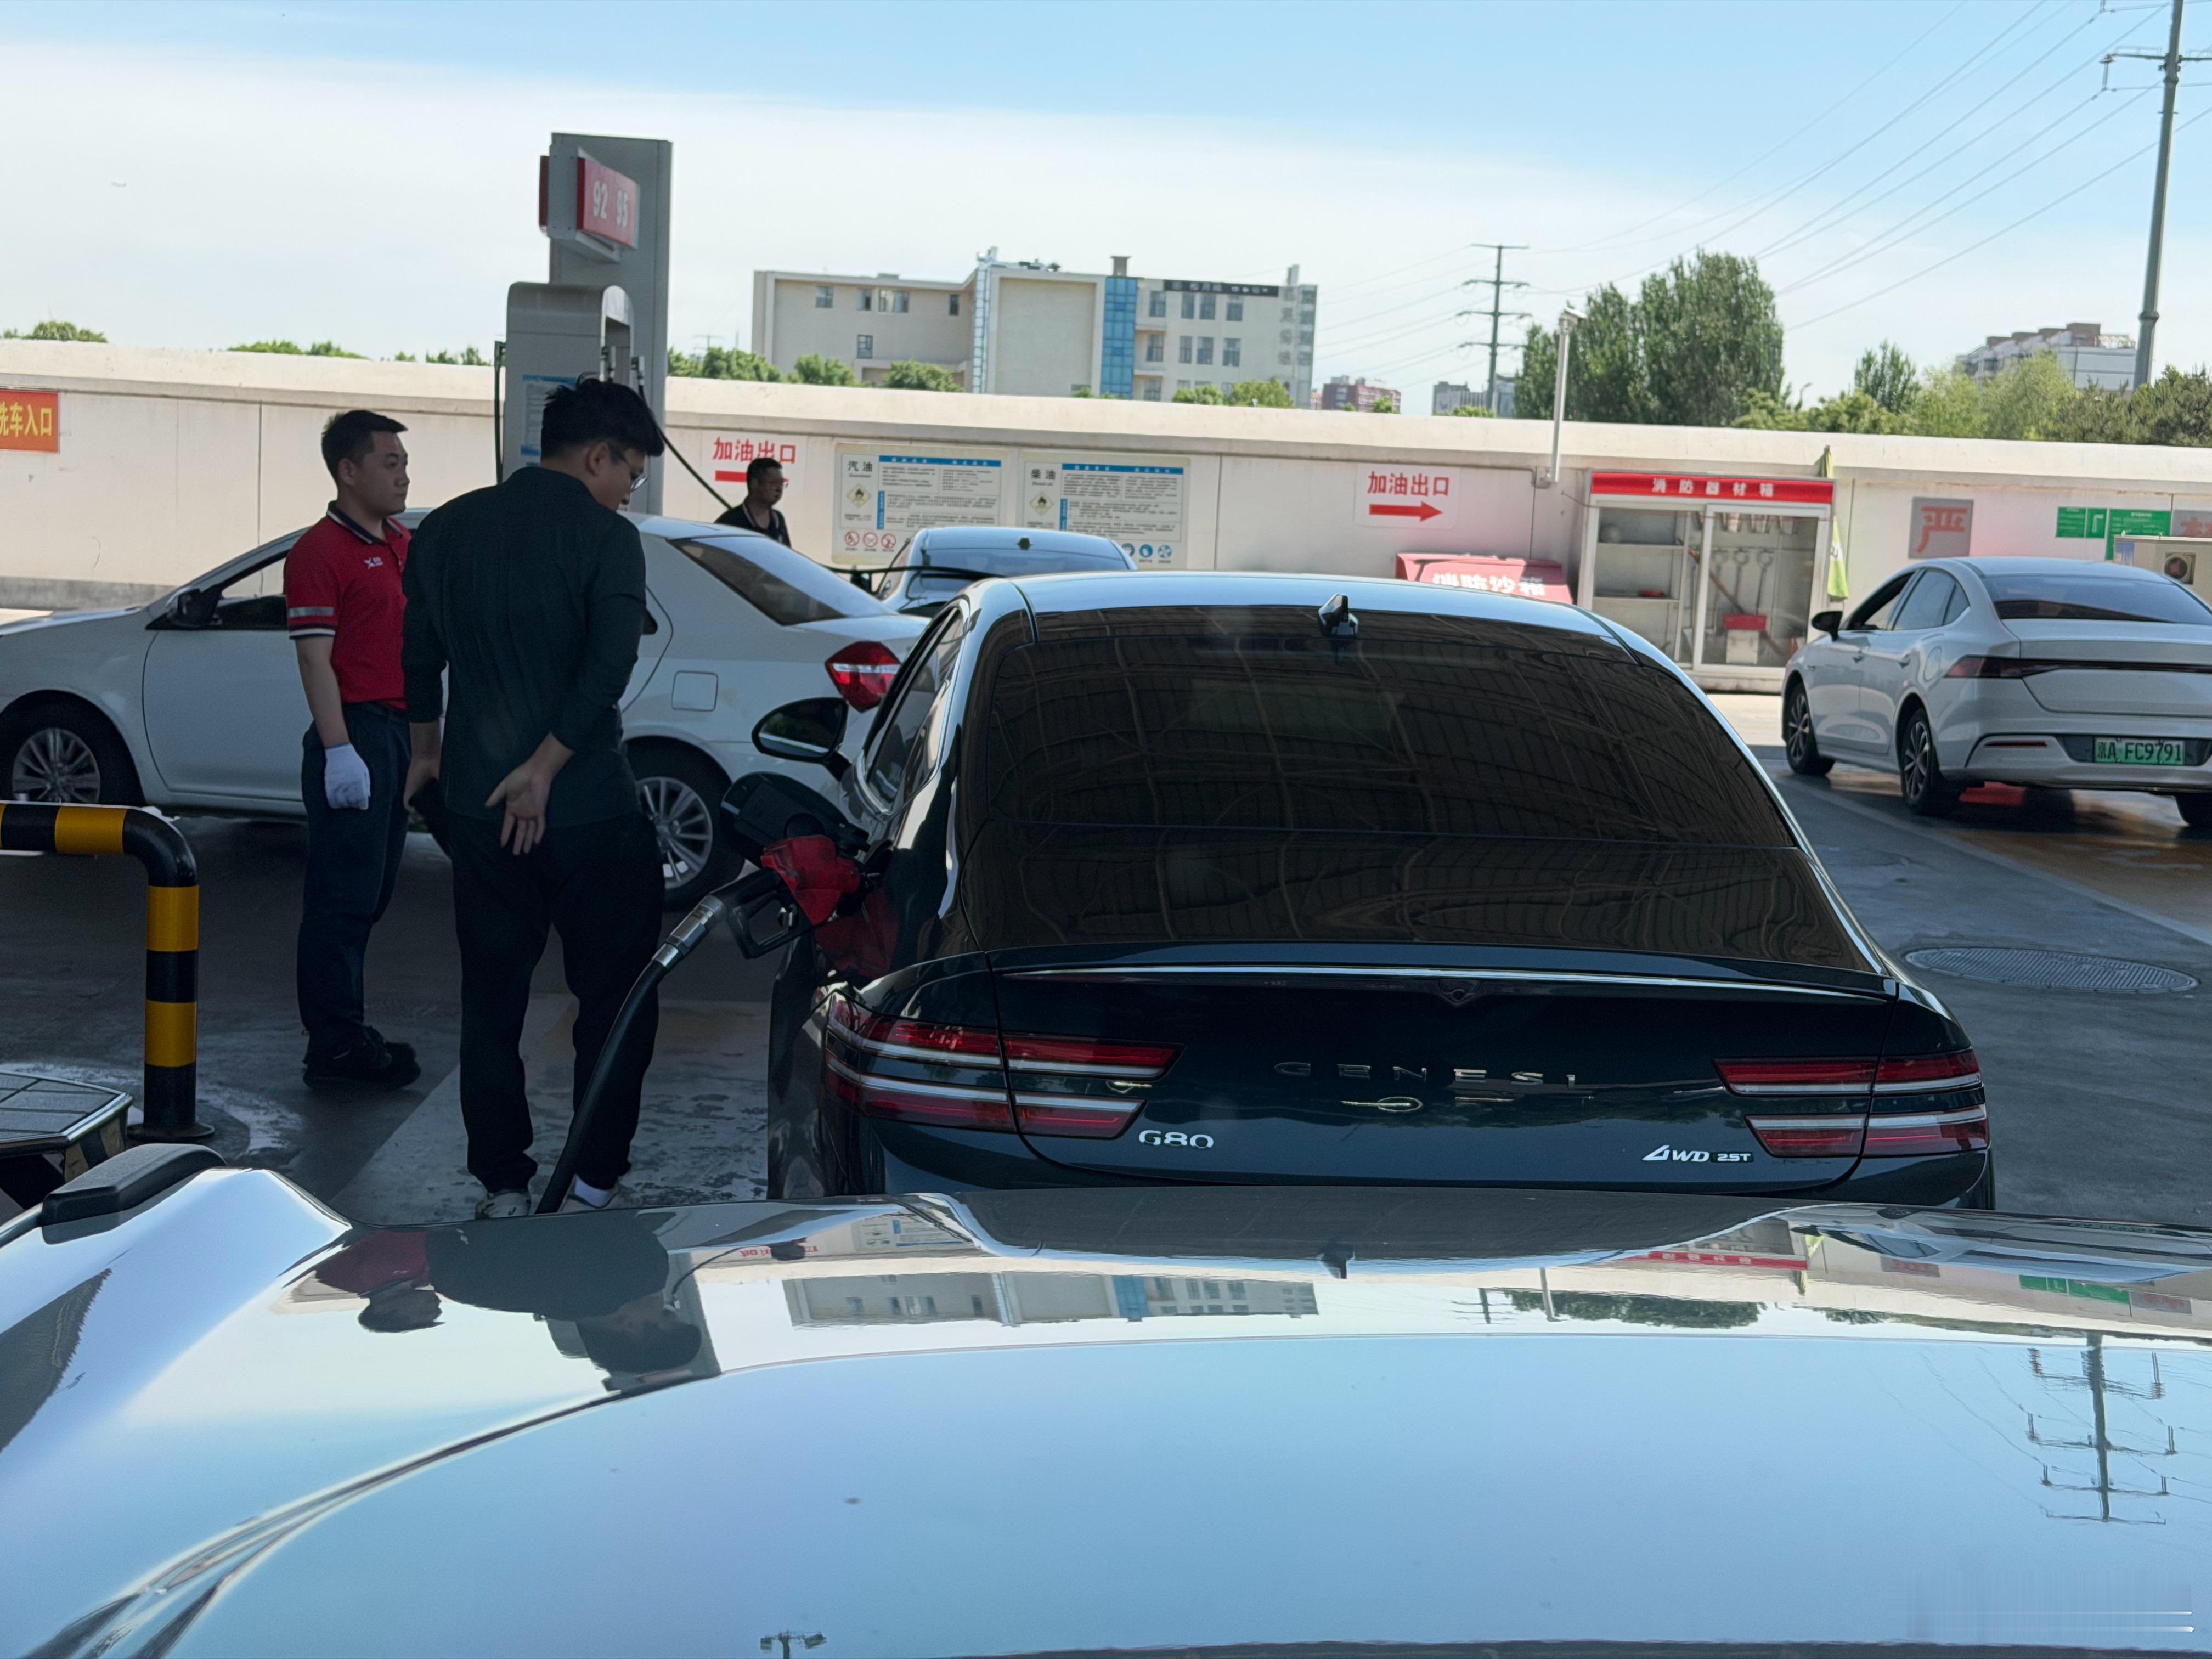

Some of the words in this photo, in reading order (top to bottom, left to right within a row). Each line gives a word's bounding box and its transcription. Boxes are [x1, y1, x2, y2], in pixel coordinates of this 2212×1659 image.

[593, 180, 608, 220] 92
[616, 189, 629, 228] 95
[712, 436, 796, 464] 加油出口
[848, 460, 873, 472] 汽油
[1031, 469, 1056, 480] 柴油
[1367, 471, 1449, 496] 加油出口
[1916, 506, 1967, 554] 严
[1139, 1130, 1214, 1149] G80
[1642, 1144, 1710, 1163] 4WD
